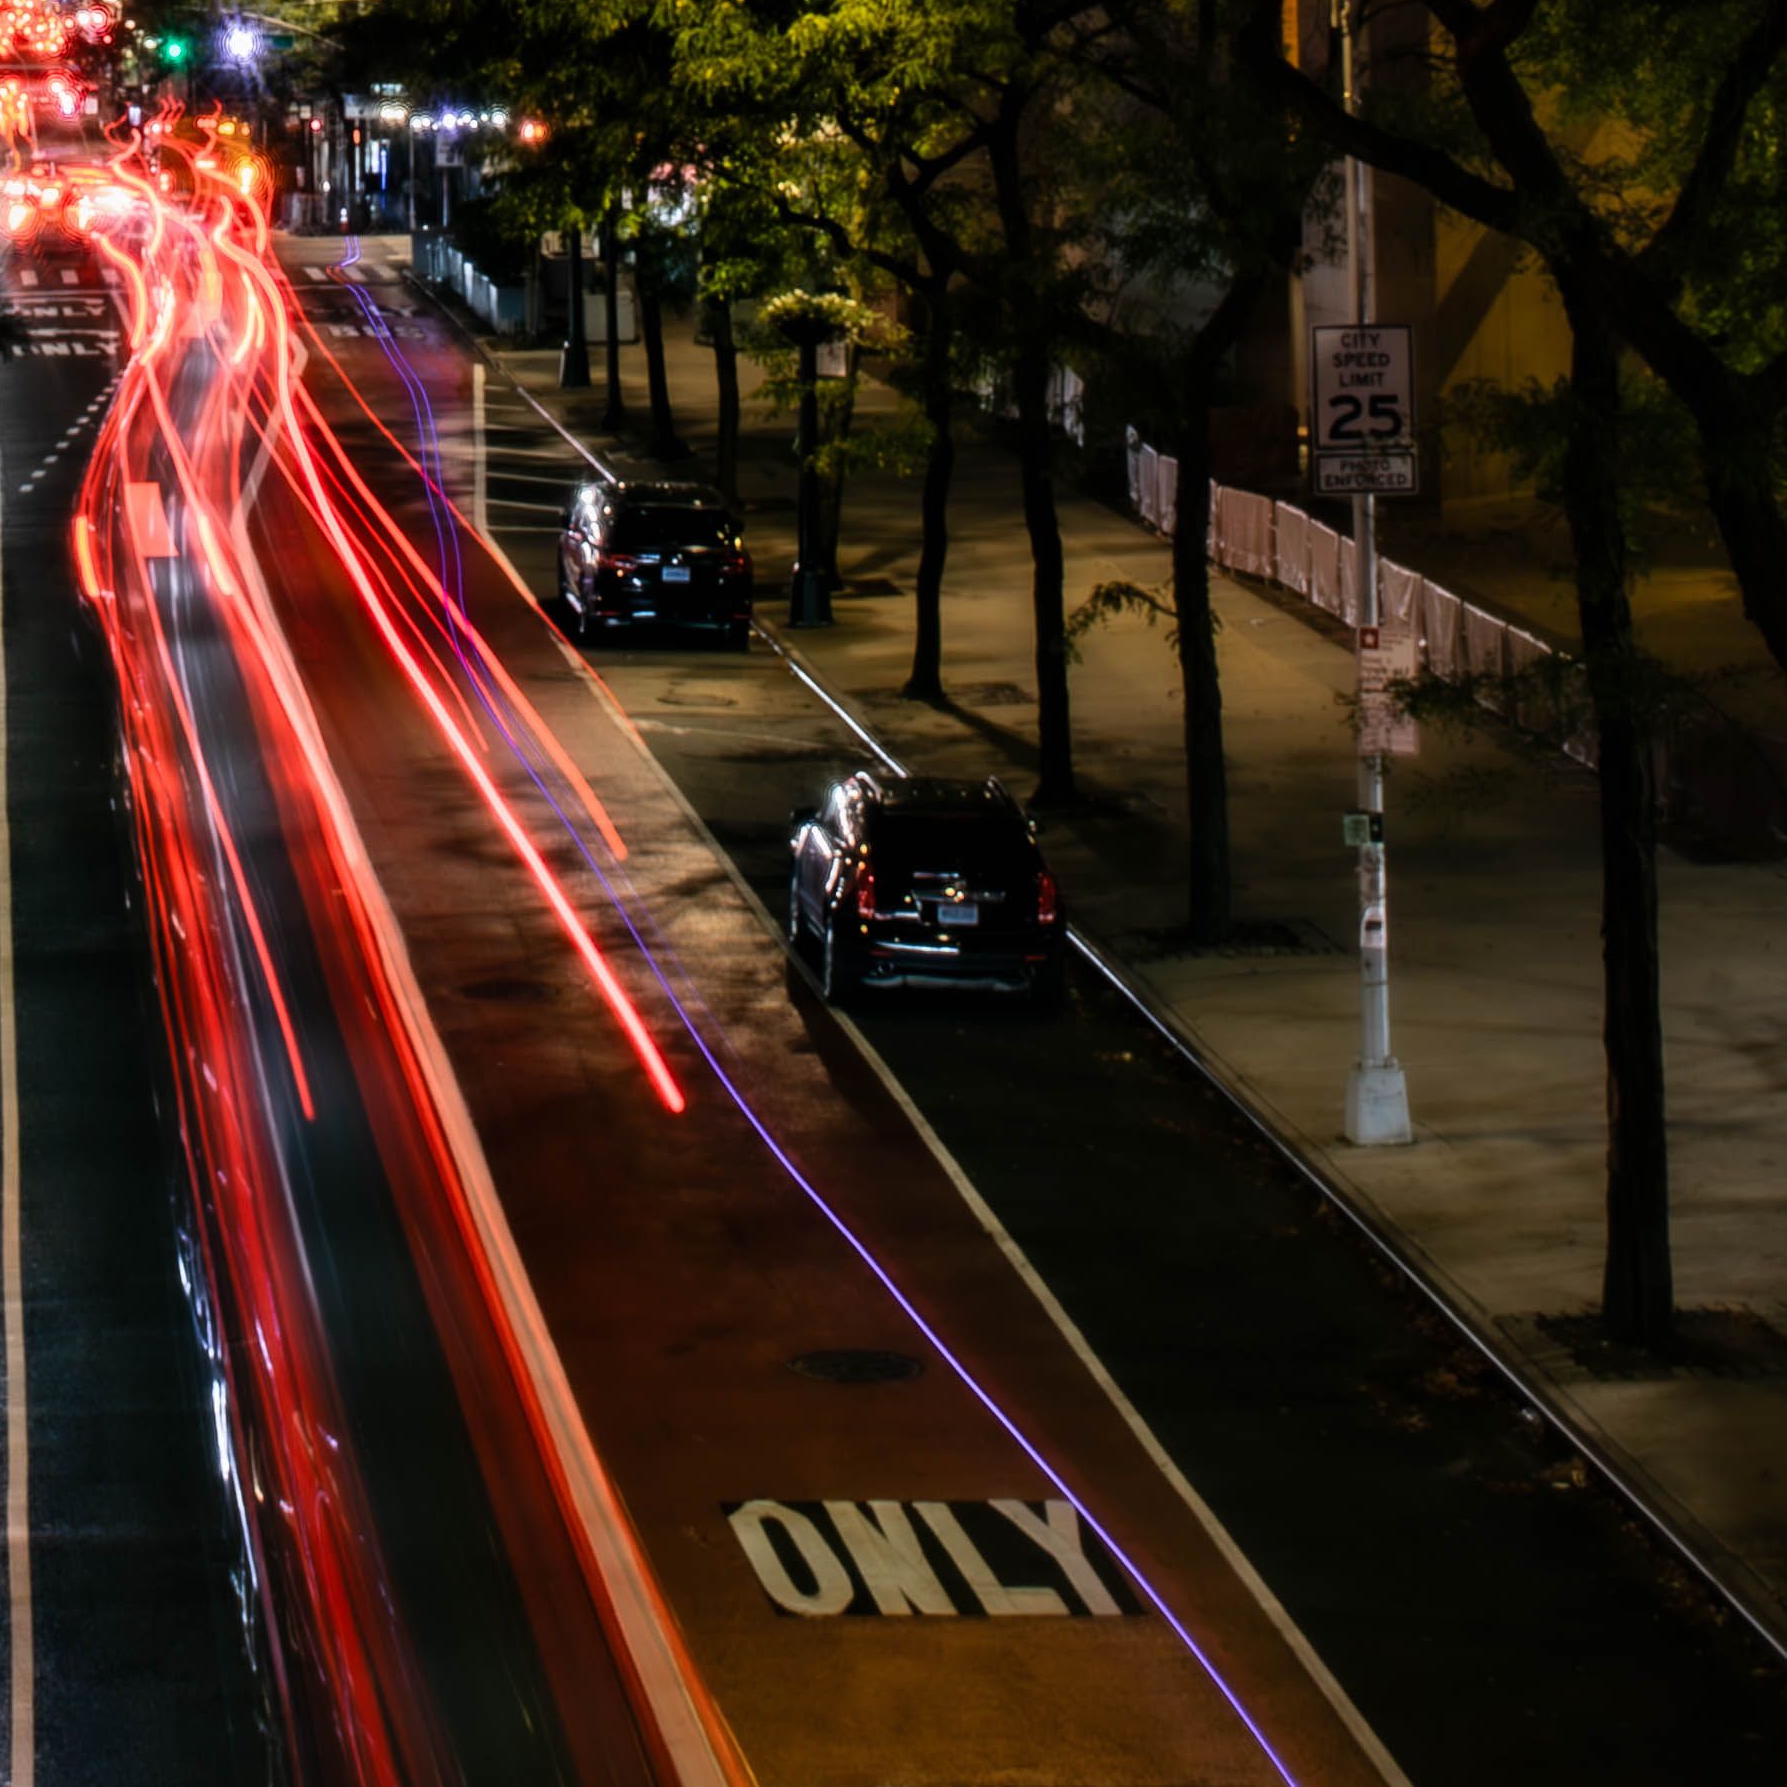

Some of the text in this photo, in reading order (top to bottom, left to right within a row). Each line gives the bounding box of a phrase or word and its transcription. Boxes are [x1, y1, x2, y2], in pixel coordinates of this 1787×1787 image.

[1341, 332, 1380, 348] CITY
[1332, 352, 1390, 368] SPEED
[1339, 372, 1384, 387] LIMIT
[1329, 394, 1401, 439] 25
[727, 1498, 1123, 1617] ONLY
